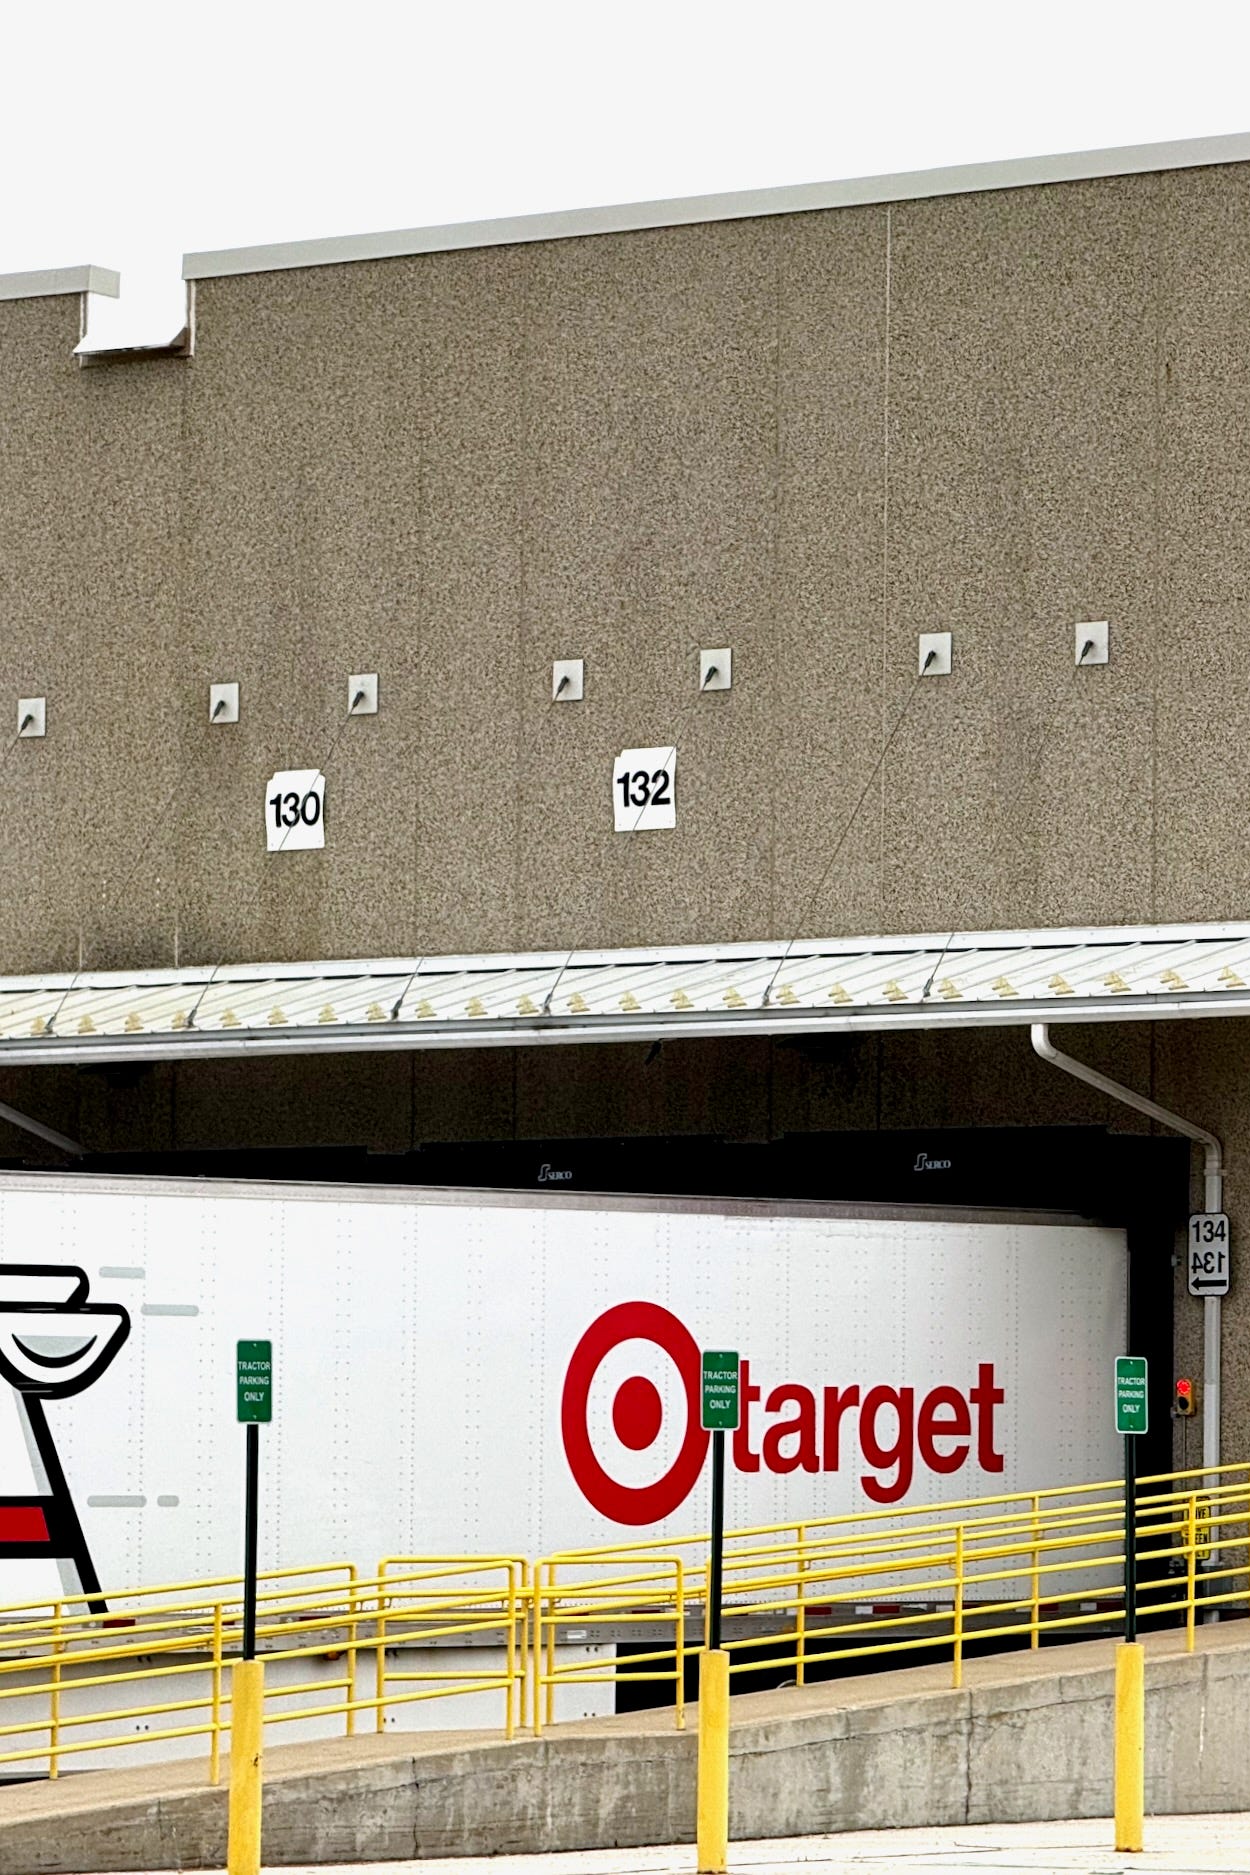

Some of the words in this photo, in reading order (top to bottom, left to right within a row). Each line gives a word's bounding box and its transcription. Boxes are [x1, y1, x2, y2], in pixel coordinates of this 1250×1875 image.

[616, 769, 671, 807] 132
[269, 791, 320, 828] 130
[1192, 1220, 1226, 1243] 134
[238, 1361, 271, 1371] TRACTOR
[703, 1371, 738, 1380] TRACTOR
[239, 1376, 270, 1385] PARKING
[1117, 1377, 1146, 1386] TRACTOR
[704, 1385, 737, 1394] PARKING
[243, 1391, 265, 1402] ONLY
[1118, 1390, 1145, 1399] PARKING
[709, 1400, 731, 1409] ONLY
[1122, 1404, 1140, 1413] ONLY
[732, 1360, 1005, 1504] target
